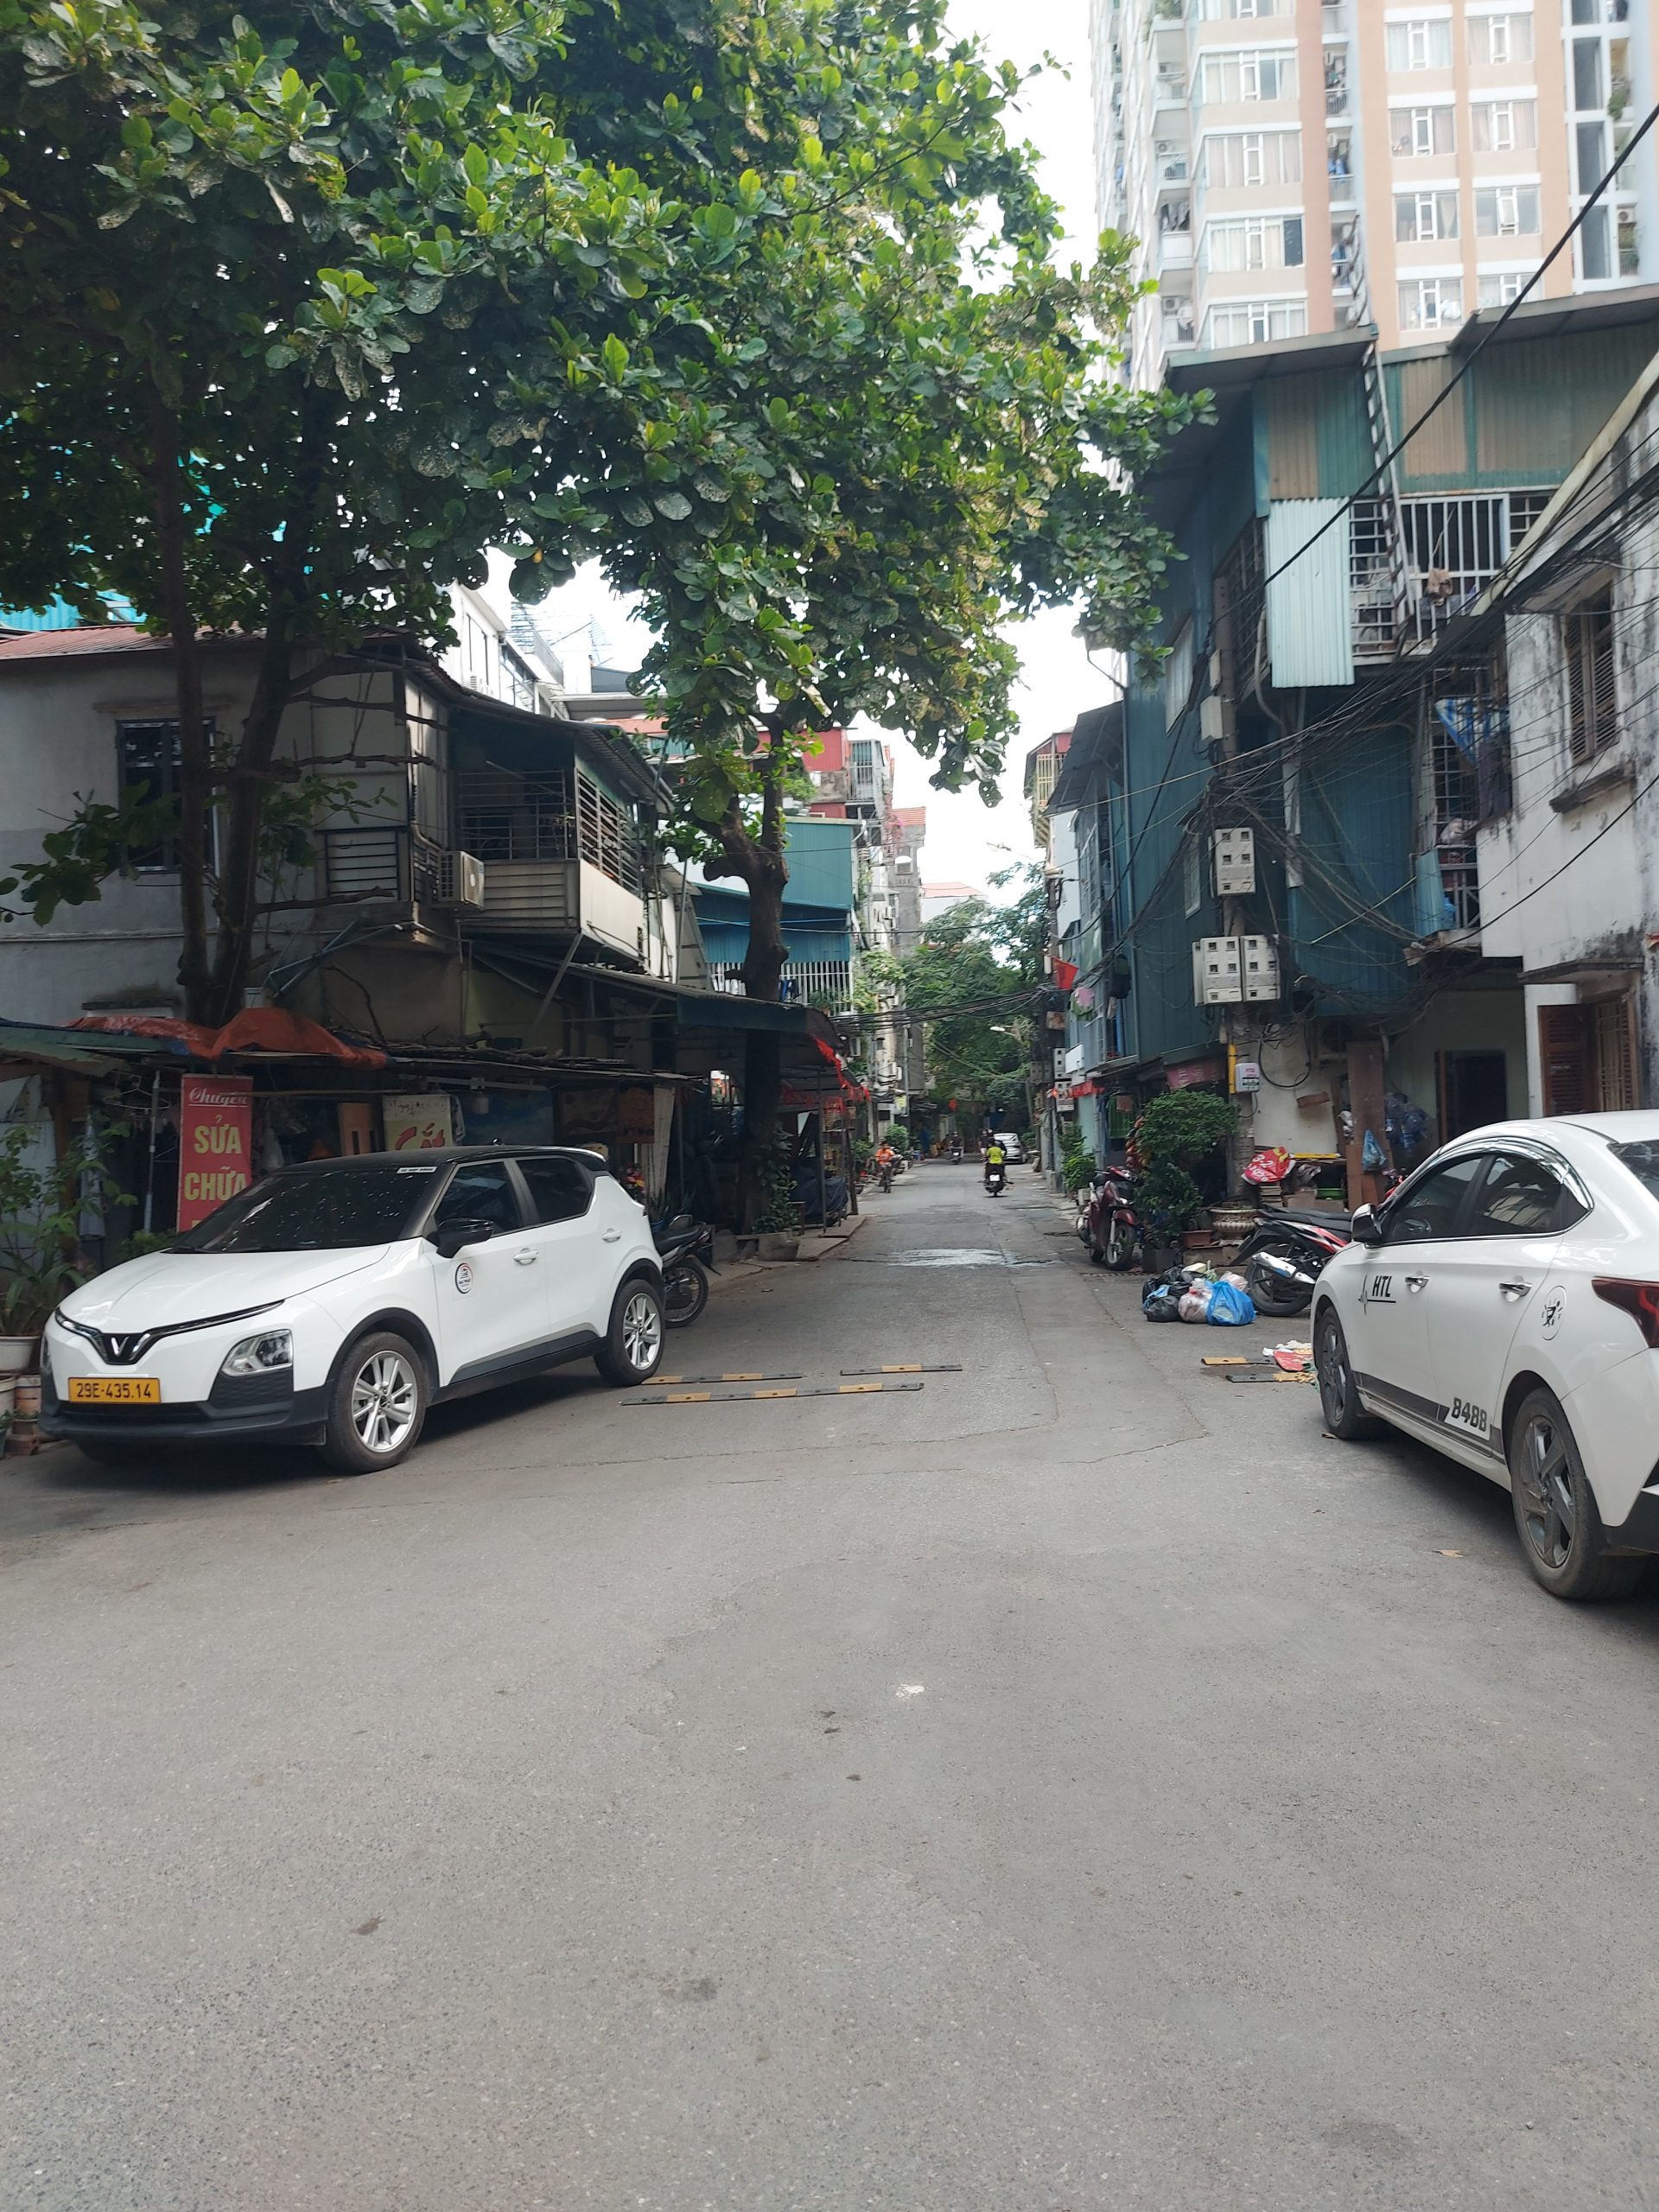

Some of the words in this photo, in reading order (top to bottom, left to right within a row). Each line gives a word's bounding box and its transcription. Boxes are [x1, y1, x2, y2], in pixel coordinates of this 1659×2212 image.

[194, 1114, 243, 1154] SỬA
[184, 1165, 248, 1201] CHỮA
[1372, 1275, 1393, 1298] HTL
[76, 1382, 152, 1399] 29E-435.14
